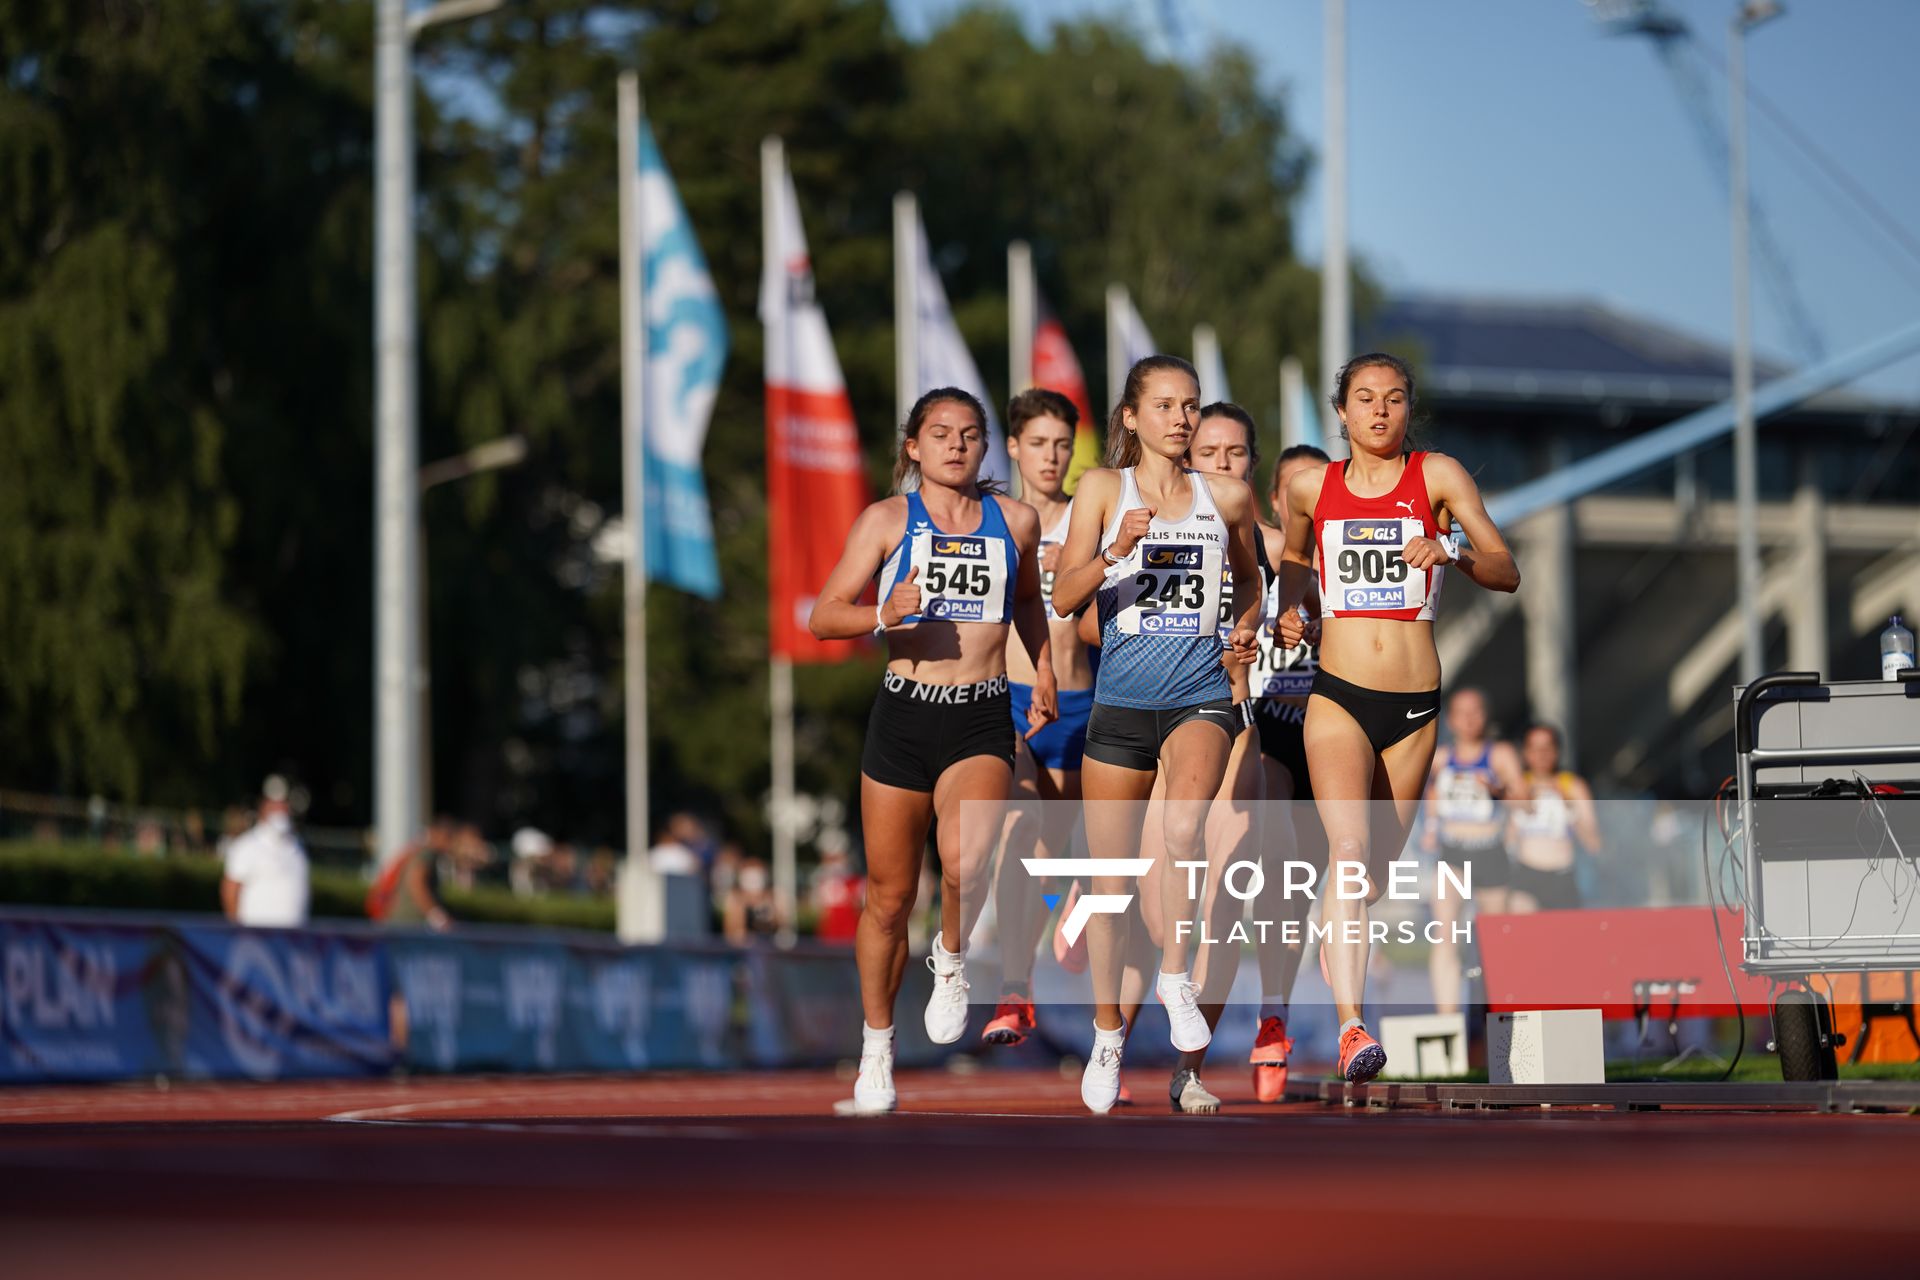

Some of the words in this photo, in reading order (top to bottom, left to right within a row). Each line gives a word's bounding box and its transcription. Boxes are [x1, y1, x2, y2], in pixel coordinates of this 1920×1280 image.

[1176, 532, 1220, 542] FINANZ
[1374, 527, 1397, 541] GLS
[960, 542, 982, 556] GLS
[1174, 552, 1198, 565] GLS
[1338, 549, 1408, 584] 905
[926, 562, 991, 597] 545
[1135, 573, 1205, 610] 243
[1369, 591, 1402, 601] PLAN
[951, 602, 982, 614] PLAN
[1165, 617, 1198, 628] PLAN
[910, 682, 970, 705] NIKE
[974, 673, 1008, 702] PRO
[1263, 698, 1305, 725] NIK
